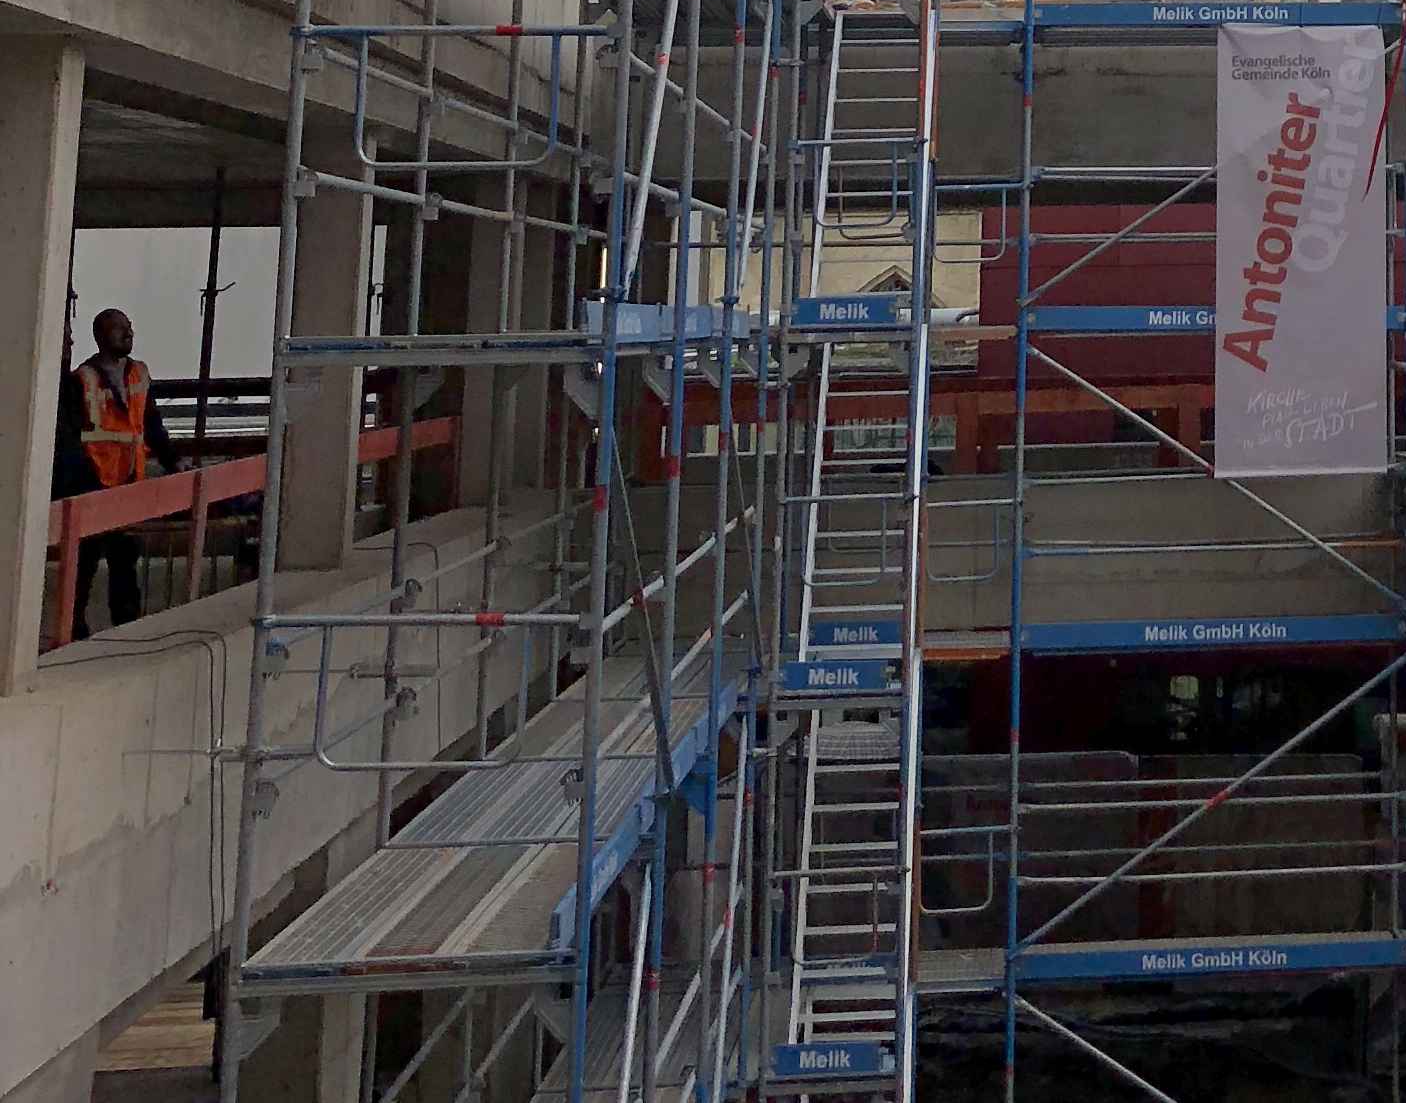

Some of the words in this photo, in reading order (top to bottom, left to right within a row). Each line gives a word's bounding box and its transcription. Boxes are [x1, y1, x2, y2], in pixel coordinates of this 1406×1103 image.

[1152, 6, 1194, 21] Melik
[1199, 6, 1248, 20] GmbH
[1253, 5, 1288, 20] Köln
[1231, 55, 1315, 70] Evangelische
[1231, 67, 1299, 81] Gemeinde
[1302, 66, 1330, 79] Köln
[1222, 92, 1321, 373] Antoniter
[820, 302, 868, 320] Melik
[1149, 310, 1191, 325] Melik
[833, 627, 878, 643] Melik
[1145, 625, 1188, 641] Melik
[1192, 624, 1244, 640] GmbH
[1250, 623, 1287, 638] Köln
[808, 668, 859, 686] Melik
[1142, 954, 1186, 970] Melik
[1191, 952, 1243, 968] GmbH
[1248, 950, 1287, 966] Köln
[800, 1050, 850, 1068] Melik
